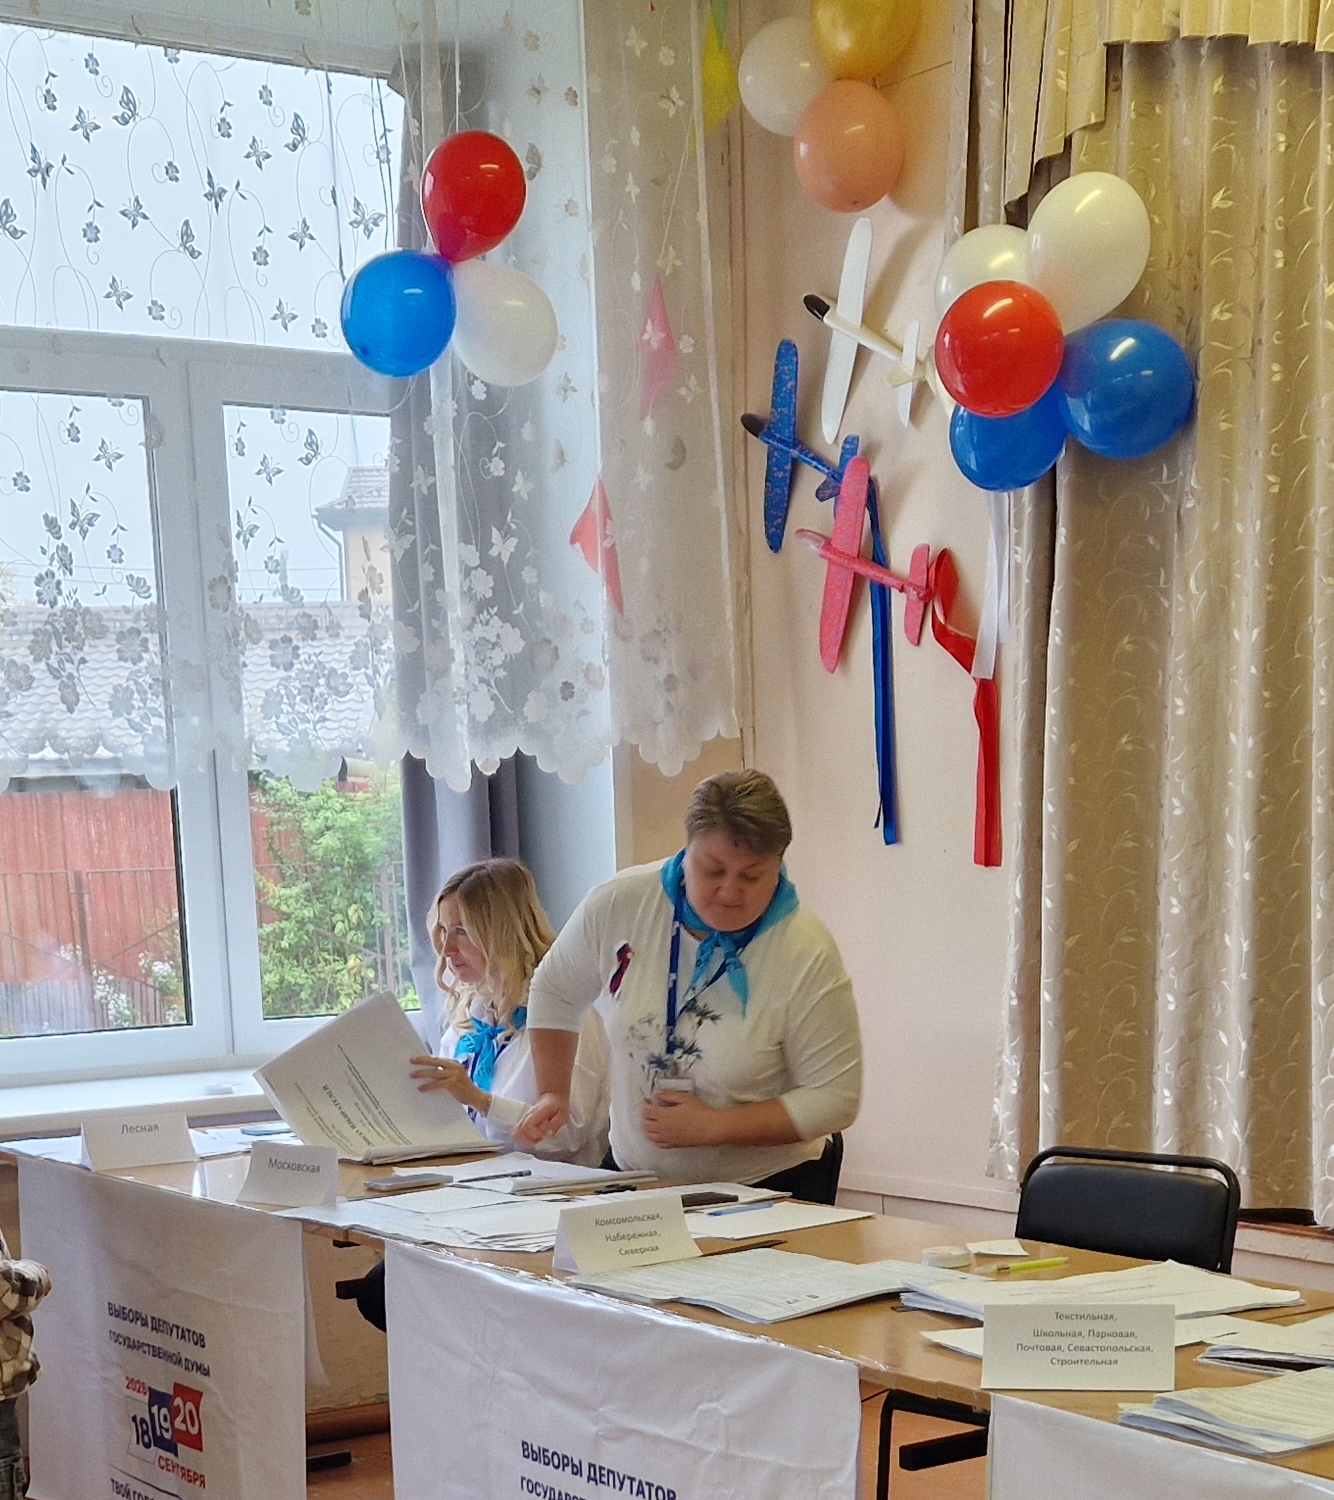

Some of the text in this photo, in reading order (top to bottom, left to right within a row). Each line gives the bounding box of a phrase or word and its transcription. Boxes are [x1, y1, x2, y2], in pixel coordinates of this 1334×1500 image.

[121, 1122, 159, 1135] Лесная
[268, 1157, 321, 1174] Московская
[595, 1213, 663, 1227] Комсомольская,
[605, 1230, 661, 1242] Набережная,
[619, 1245, 660, 1256] Северная
[1054, 1311, 1117, 1322] Текстильная,
[107, 1301, 206, 1349] ВЫБОРЫ ДЕПУТАТОВ
[1032, 1329, 1138, 1340] Школьная, Парковая,
[108, 1329, 211, 1378] ГОСУДАРСТВЕННОЙ ДУМЫ
[1016, 1343, 1153, 1353] Почтовая, Севастопольская,
[1050, 1357, 1118, 1367] Строительная
[125, 1375, 148, 1396] 2026
[131, 1396, 200, 1450] 18 19 20
[521, 1439, 583, 1478] ВЫБОРЫ
[157, 1454, 206, 1489] СЕНТЯБРЯ
[110, 1477, 132, 1500] ТВОЙ
